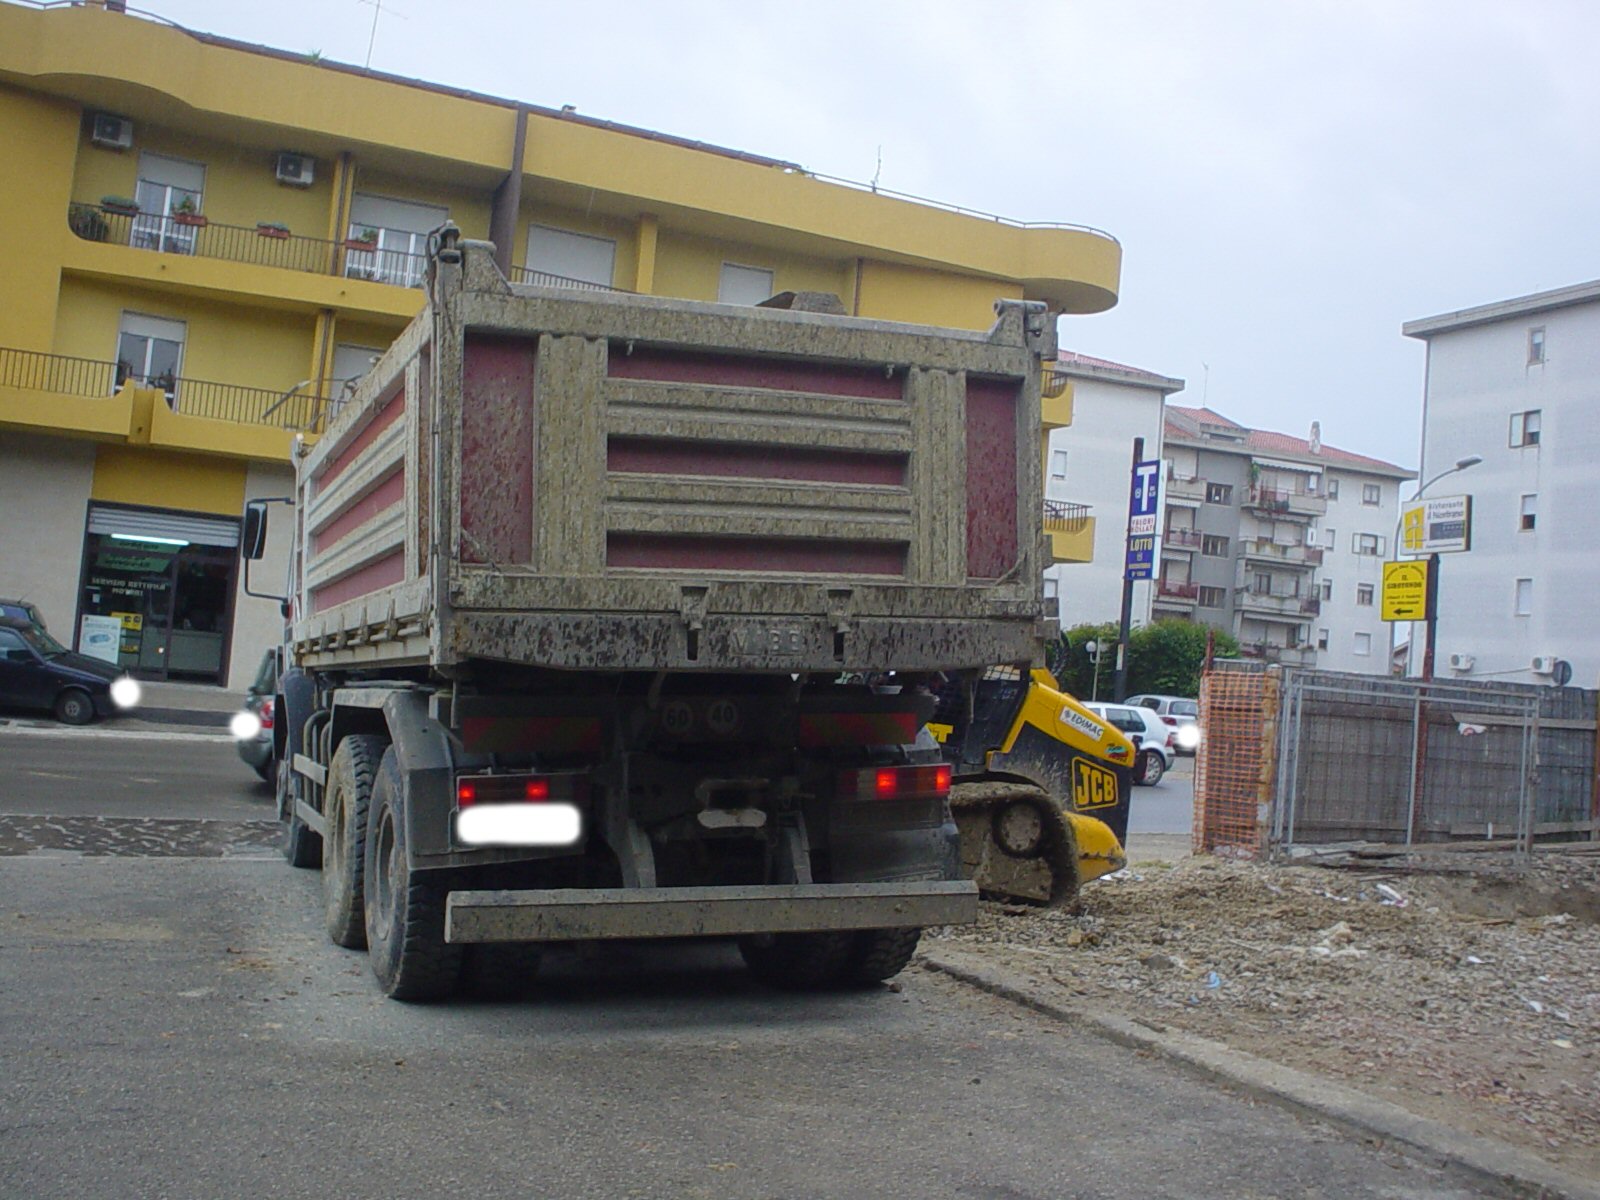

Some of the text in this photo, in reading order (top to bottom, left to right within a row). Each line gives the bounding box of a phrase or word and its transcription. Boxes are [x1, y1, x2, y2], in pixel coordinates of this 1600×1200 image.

[1136, 465, 1158, 512] T
[1130, 538, 1153, 551] LOTTO
[667, 705, 734, 727] 60 40
[1076, 764, 1115, 805] JCB
